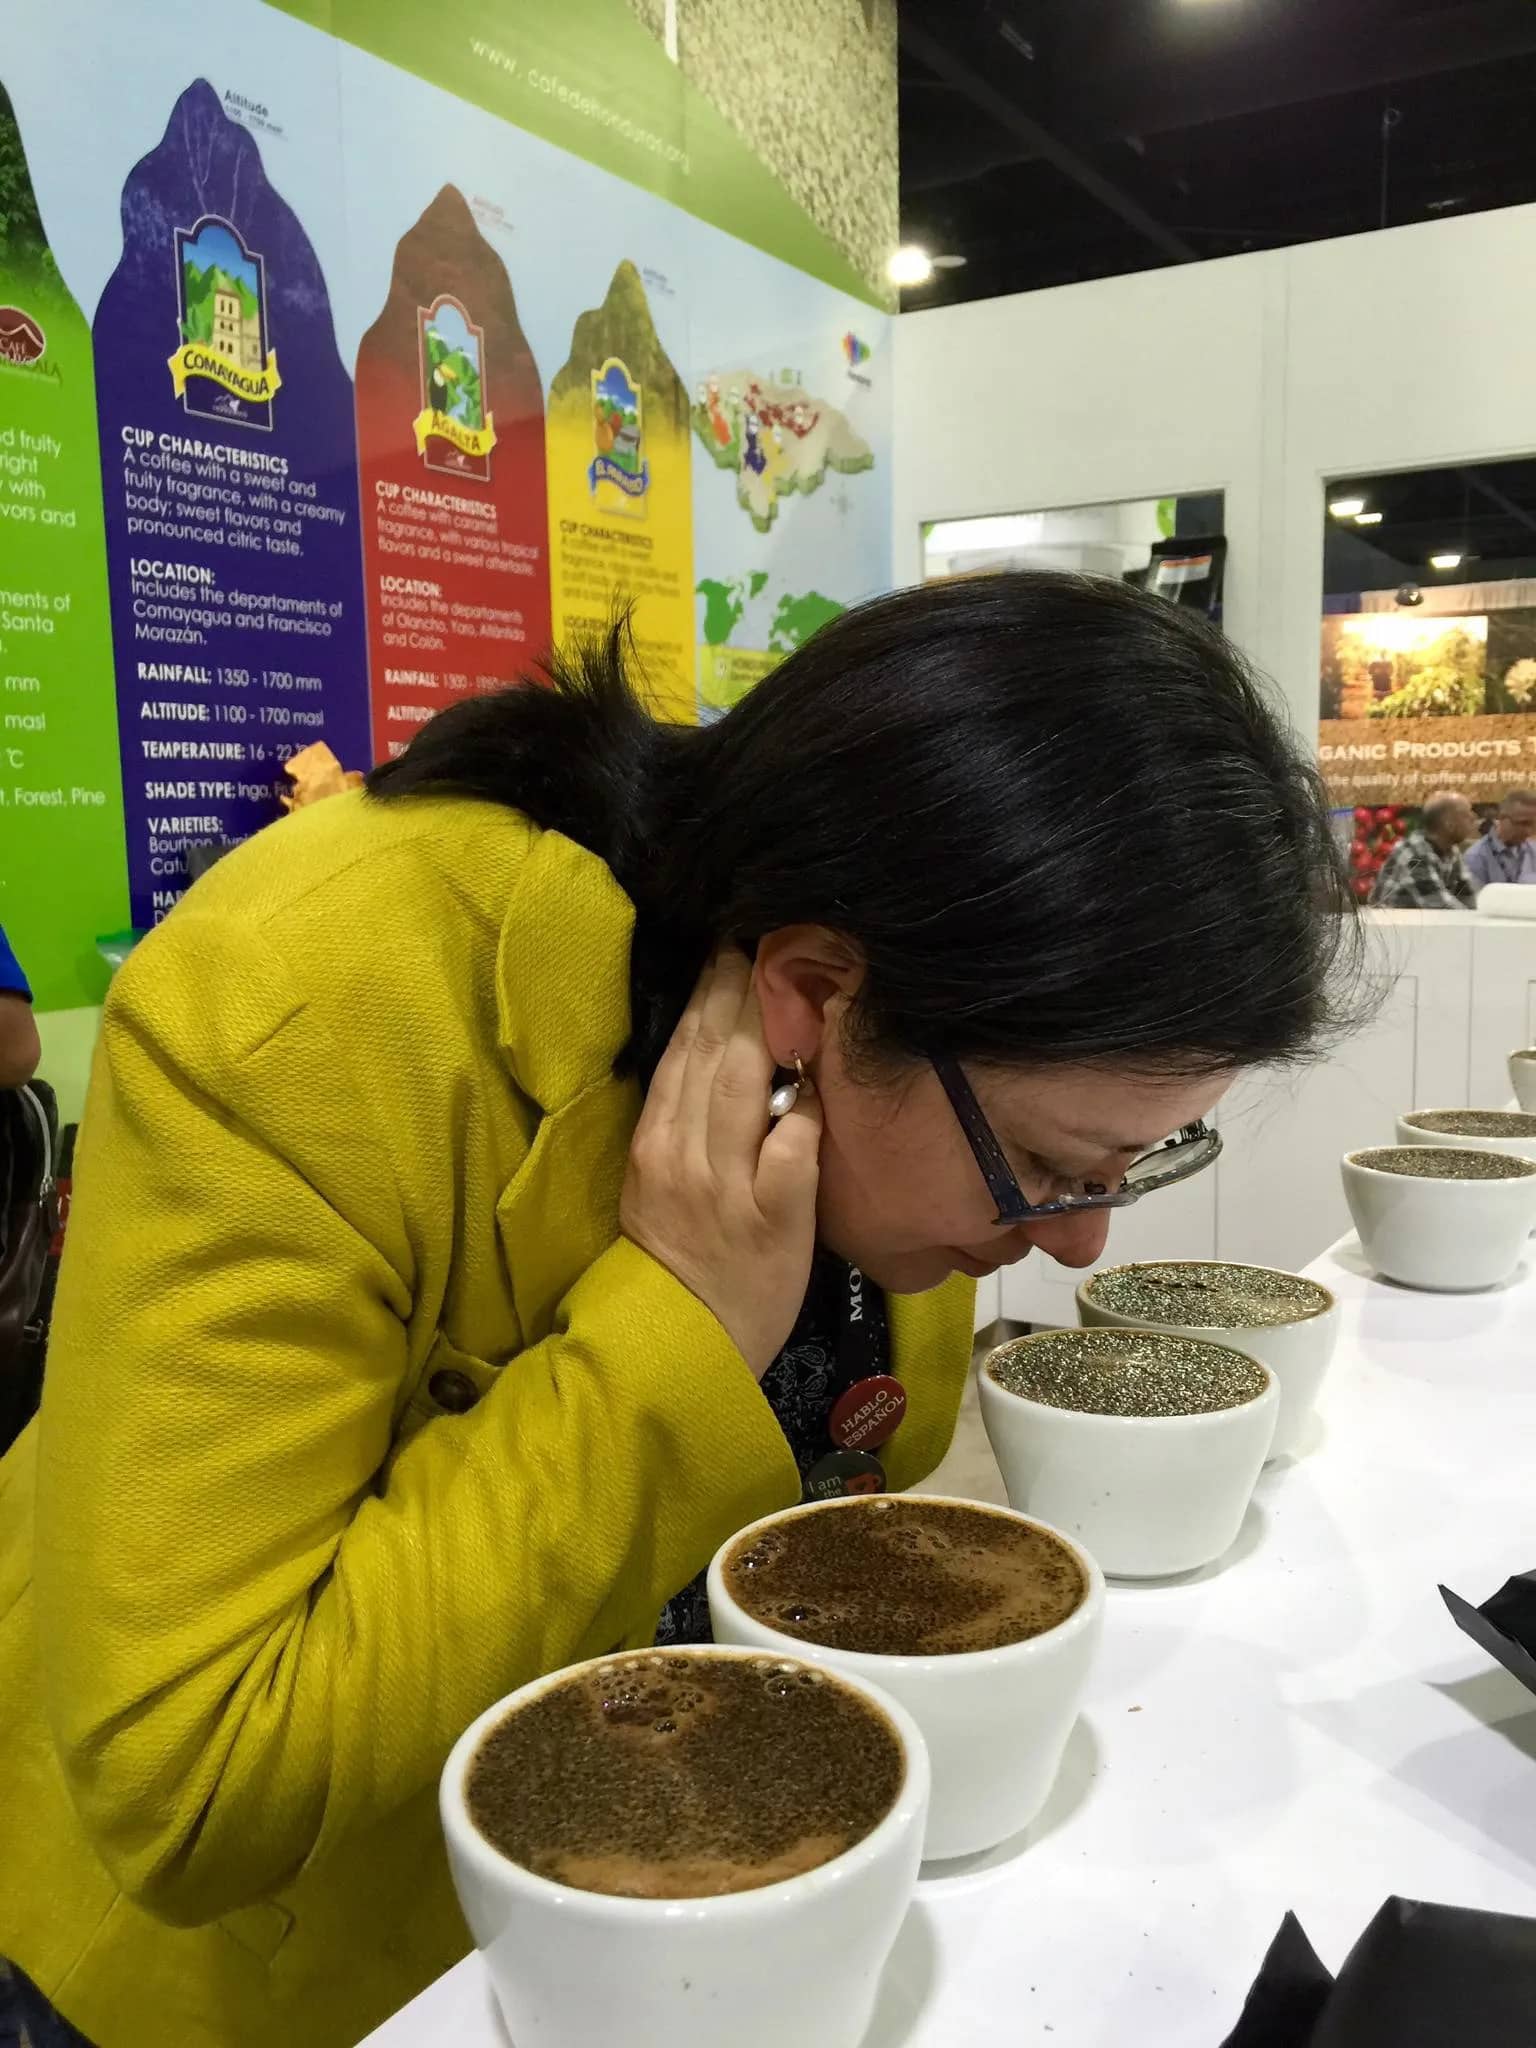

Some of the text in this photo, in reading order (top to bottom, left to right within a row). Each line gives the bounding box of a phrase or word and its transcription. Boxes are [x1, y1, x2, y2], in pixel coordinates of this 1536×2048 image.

[183, 351, 269, 395] COMAYAGUA
[20, 430, 61, 458] fruity
[122, 426, 289, 474] CUP CHARACTERISTICS
[123, 448, 316, 498] A coffee with a sweet and
[9, 479, 46, 499] with
[124, 468, 346, 526] fruity fragrance, with a creamy
[376, 480, 497, 519] CUP CHARACTERISTICS
[41, 510, 76, 528] and
[126, 491, 302, 536] body; sweet flavors and
[377, 500, 386, 513] A
[389, 502, 426, 520] coffee
[128, 517, 304, 556] pronounced citric taste.
[417, 545, 441, 560] and
[130, 558, 216, 585] LOCATION:
[54, 593, 72, 612] of
[132, 578, 342, 618] Includes the departaments of
[2, 611, 54, 633] Santa
[133, 599, 332, 636] Comayagua and Francisco
[135, 624, 208, 645] Morazán.
[5, 675, 40, 692] mm
[138, 662, 212, 685] RAINFALL:
[217, 669, 250, 688] 1350
[262, 672, 293, 690] 1700
[296, 677, 322, 692] mm
[5, 713, 46, 730] masl
[140, 702, 210, 722] ALTITUDE:
[215, 706, 246, 722] 1100
[260, 708, 290, 726] 1700
[293, 710, 324, 727] masl
[142, 740, 246, 760] TEMPERATURE:
[250, 744, 265, 761] 16
[1393, 739, 1522, 760] PRODUCTS
[1352, 774, 1399, 788] quality
[1402, 772, 1417, 786] of
[1422, 771, 1466, 786] coffee
[1470, 771, 1498, 783] and
[1500, 769, 1524, 782] the
[72, 788, 105, 805] Pine
[146, 782, 196, 800] SHADE
[200, 782, 236, 800] TYPE:
[238, 782, 272, 802] Inga,
[148, 816, 223, 834] VARIETIES:
[841, 1390, 888, 1433] HABLO
[844, 1394, 904, 1448] ESPAÑOL
[818, 1476, 841, 1490] am
